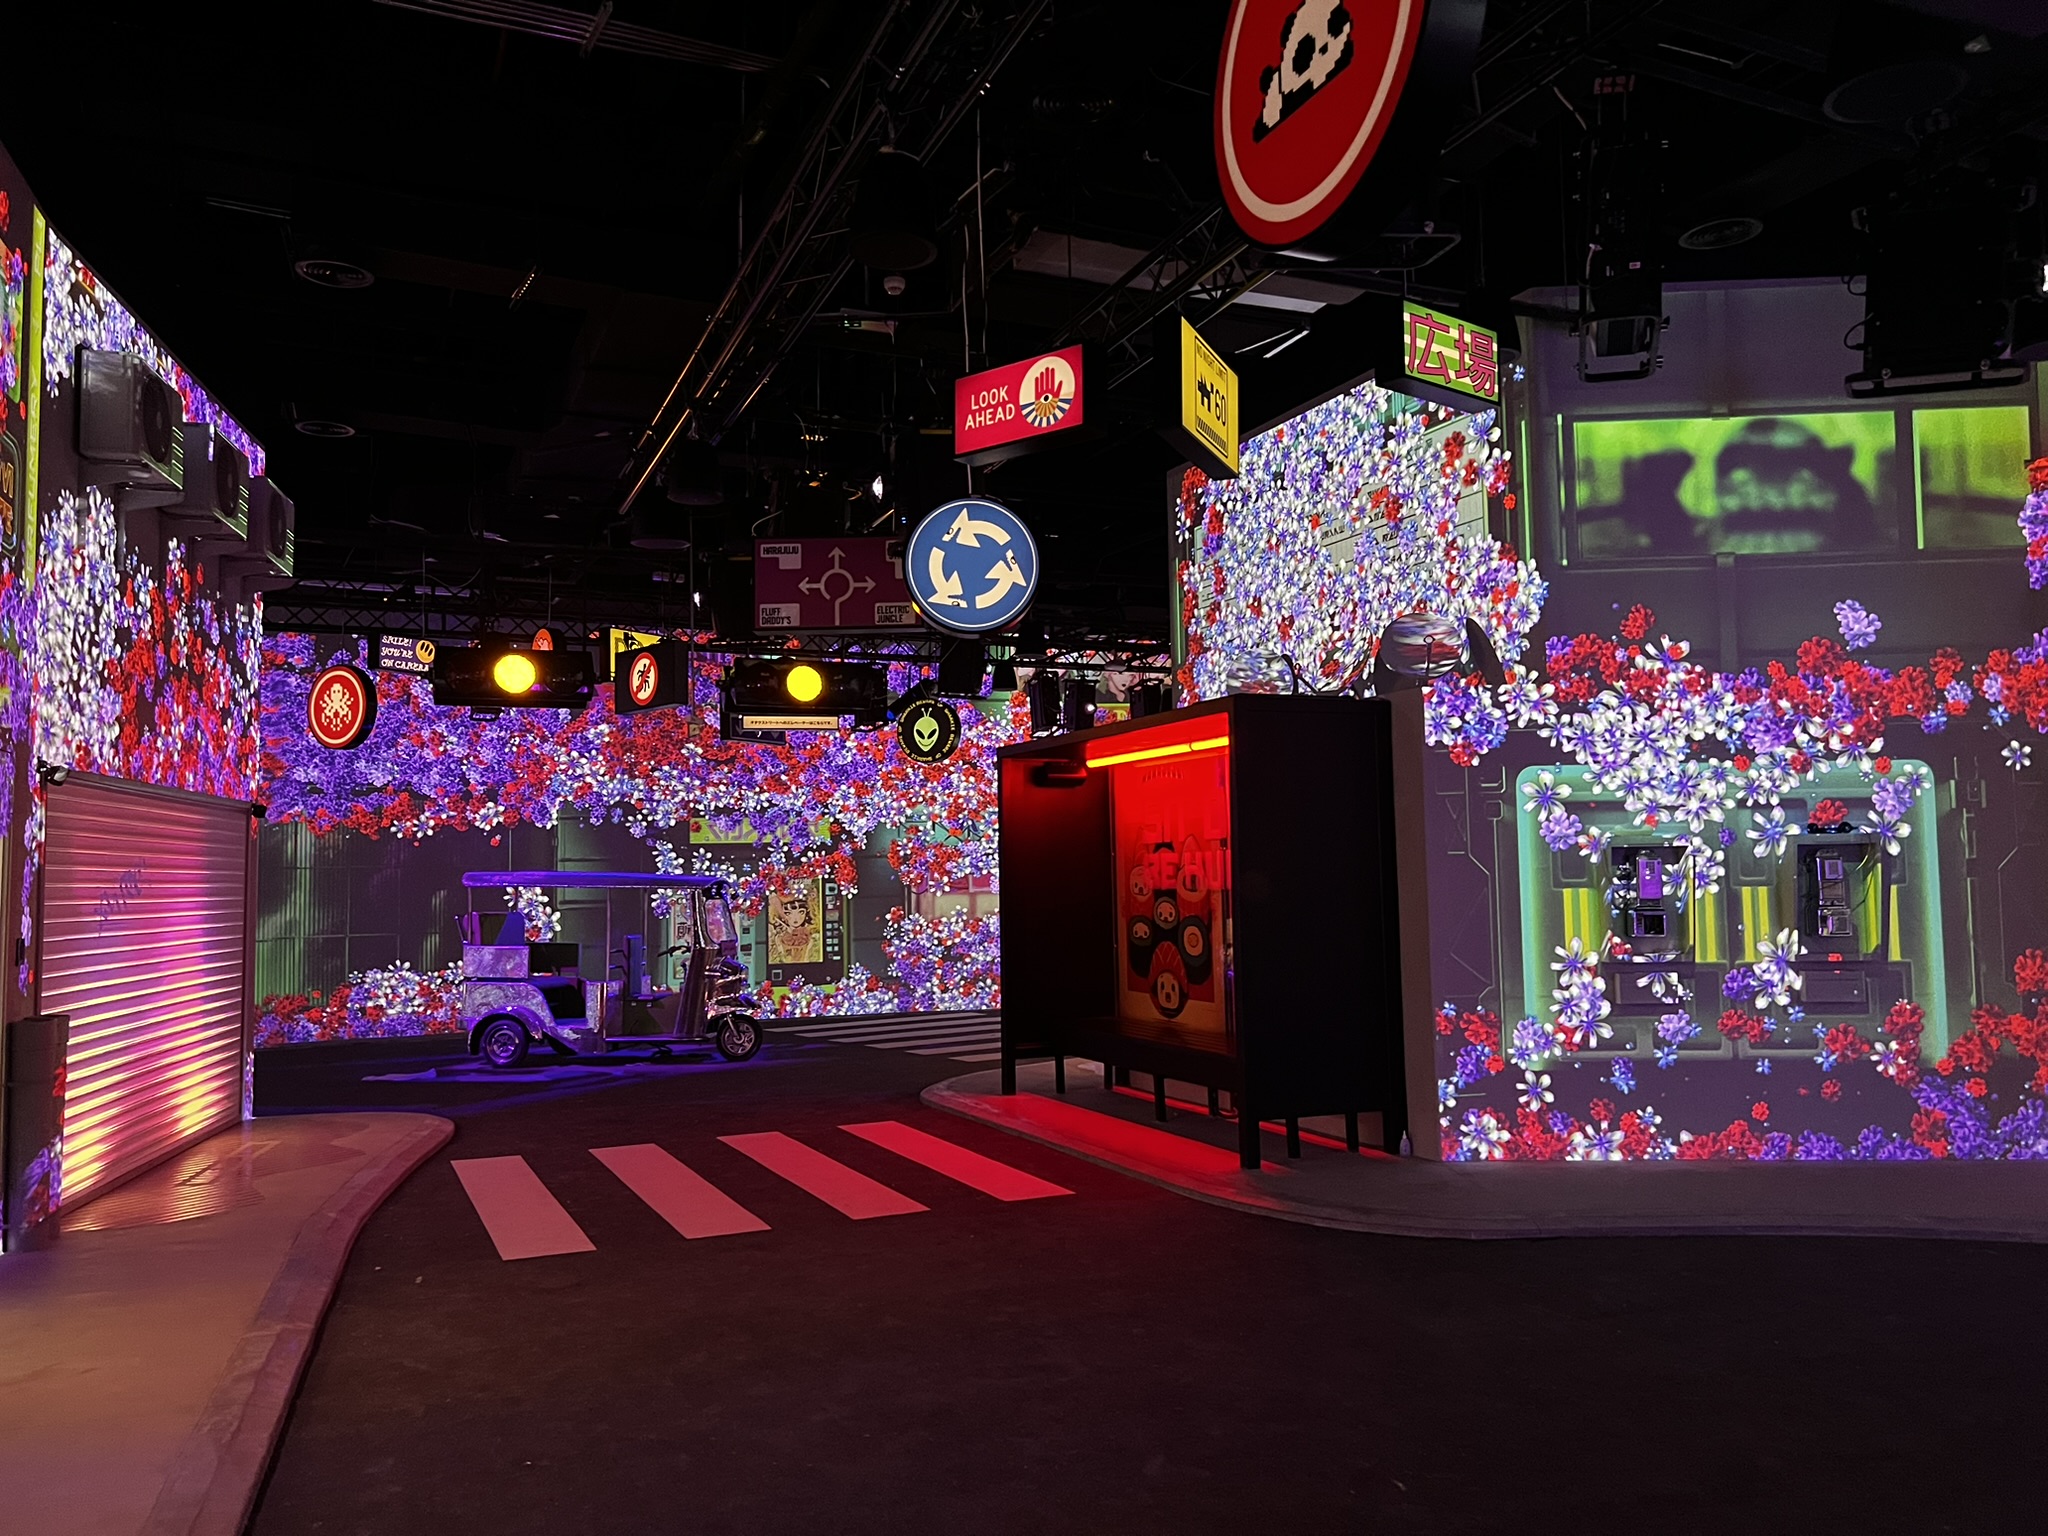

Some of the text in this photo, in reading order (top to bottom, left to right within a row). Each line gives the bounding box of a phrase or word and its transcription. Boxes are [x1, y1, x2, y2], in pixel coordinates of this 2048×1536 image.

[1408, 313, 1496, 397] 広場
[971, 385, 1009, 410] LOOK
[1215, 388, 1226, 427] 60
[965, 404, 1015, 431] AHEAD
[761, 607, 780, 616] FLUFF
[877, 605, 909, 614] ELECTRIC
[876, 614, 903, 623] JUNGLE
[382, 635, 413, 646] SMILE!
[381, 647, 413, 658] YOU'RE
[382, 659, 429, 671] ON CAMERA
